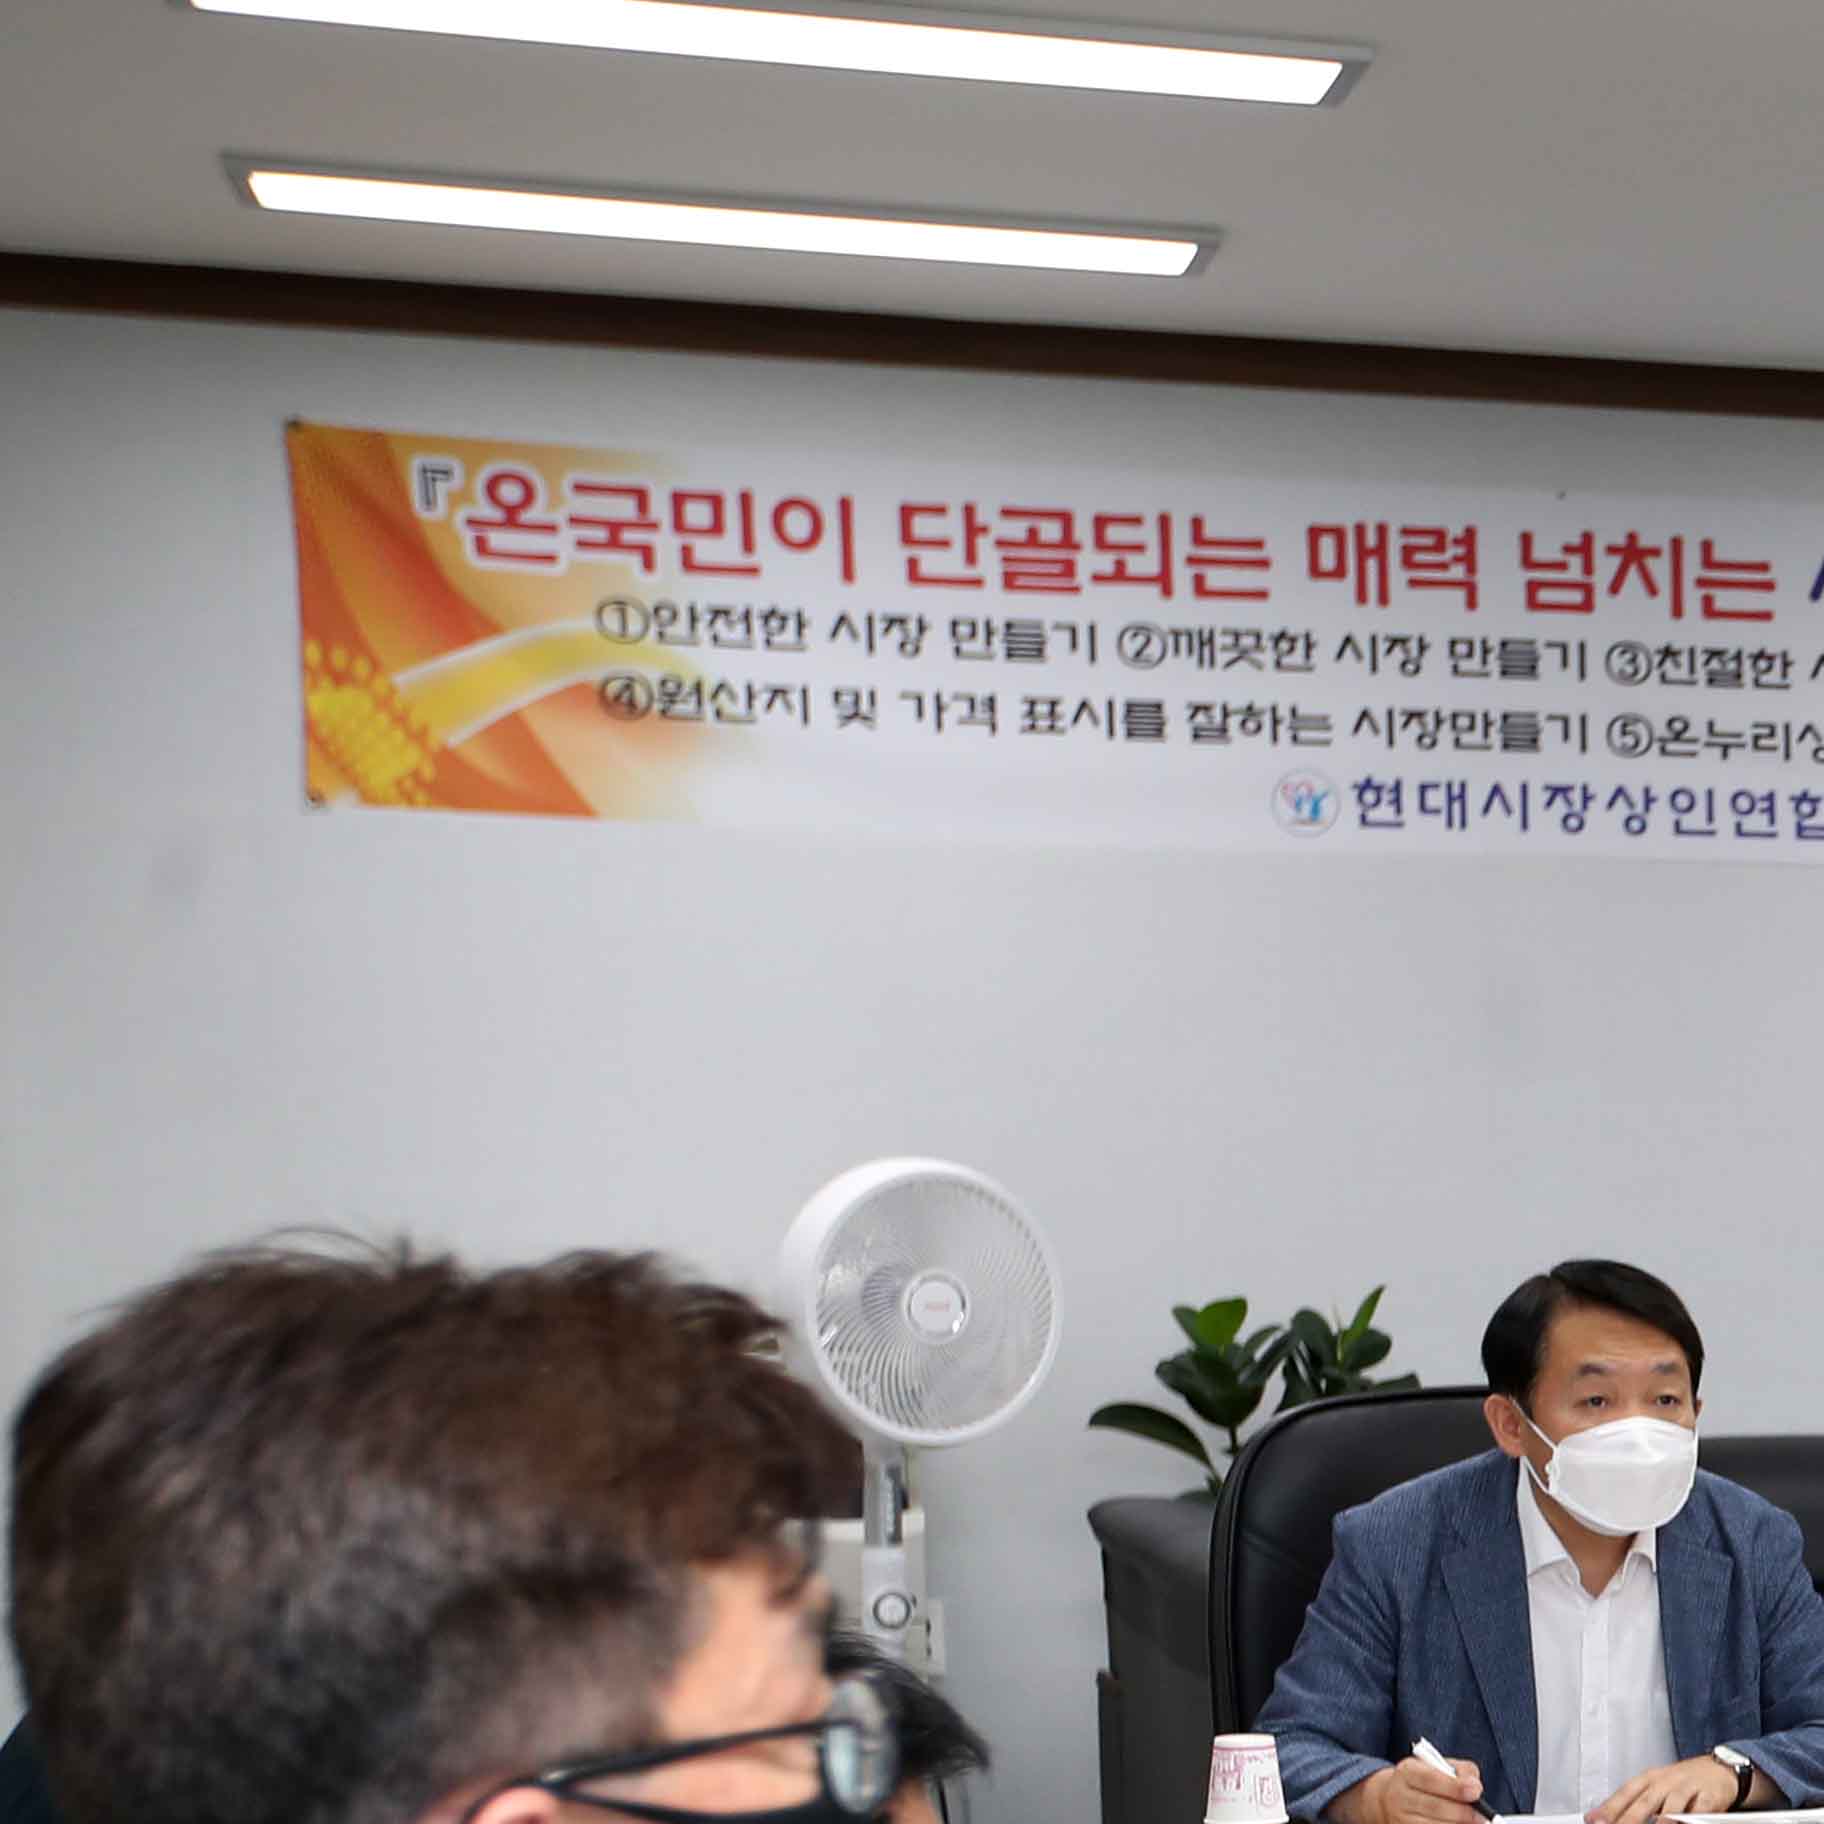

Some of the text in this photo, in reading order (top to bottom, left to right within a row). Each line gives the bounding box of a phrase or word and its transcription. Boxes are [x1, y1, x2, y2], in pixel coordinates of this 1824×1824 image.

[899, 502, 1273, 602] 단골되는
[1306, 522, 1478, 611] 매력
[1520, 531, 1776, 622] 넘치는
[830, 612, 929, 658] 시장
[949, 618, 1097, 664] 만들기
[1335, 634, 1430, 677] 시장
[1448, 637, 1586, 681] 만들기
[832, 688, 877, 728] 및
[900, 691, 998, 736] 가격
[1020, 696, 1166, 740] 표시를
[1186, 701, 1332, 746] 잘하는
[1352, 707, 1587, 754] 시장만들기
